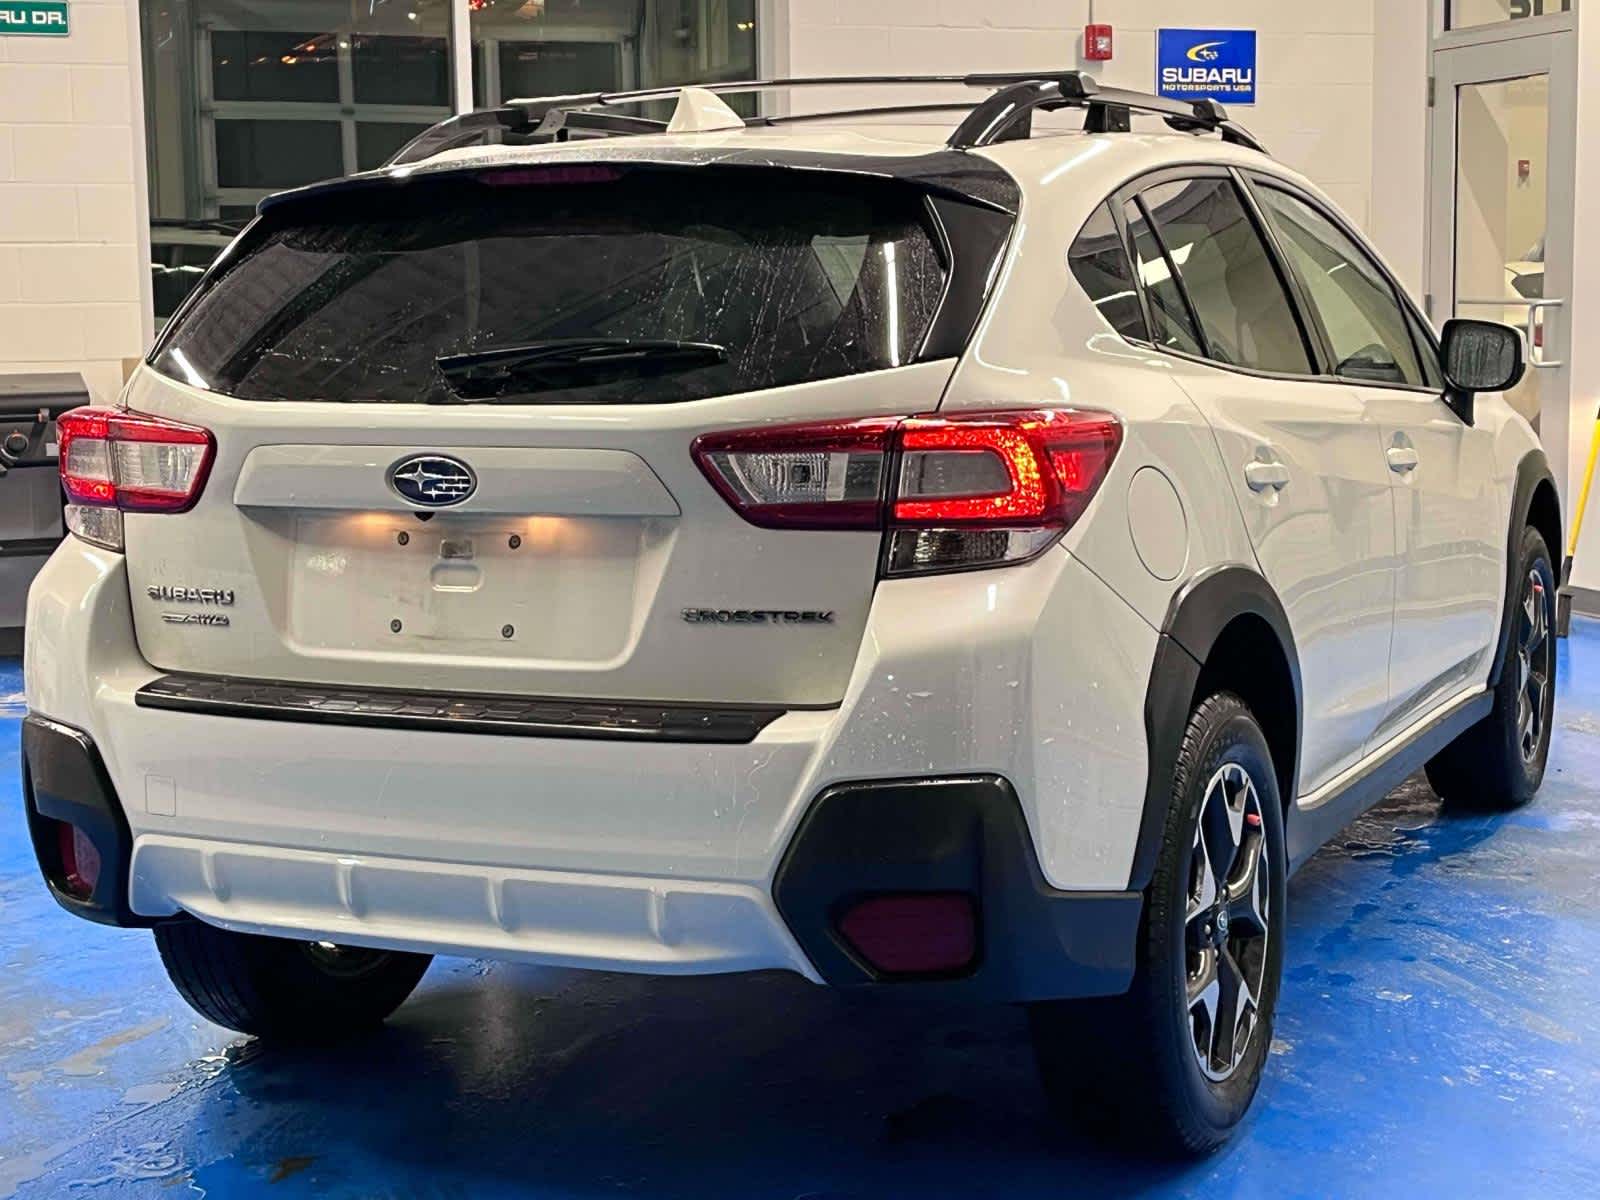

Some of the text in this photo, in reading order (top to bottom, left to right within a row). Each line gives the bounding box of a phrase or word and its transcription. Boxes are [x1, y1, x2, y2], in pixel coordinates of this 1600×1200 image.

[32, 11, 66, 25] DR.
[1162, 67, 1252, 83] SUBARU
[1162, 83, 1252, 92] MOTORSPORTS USA
[147, 585, 234, 605] SUBARU
[681, 608, 834, 624] CROSSTREK
